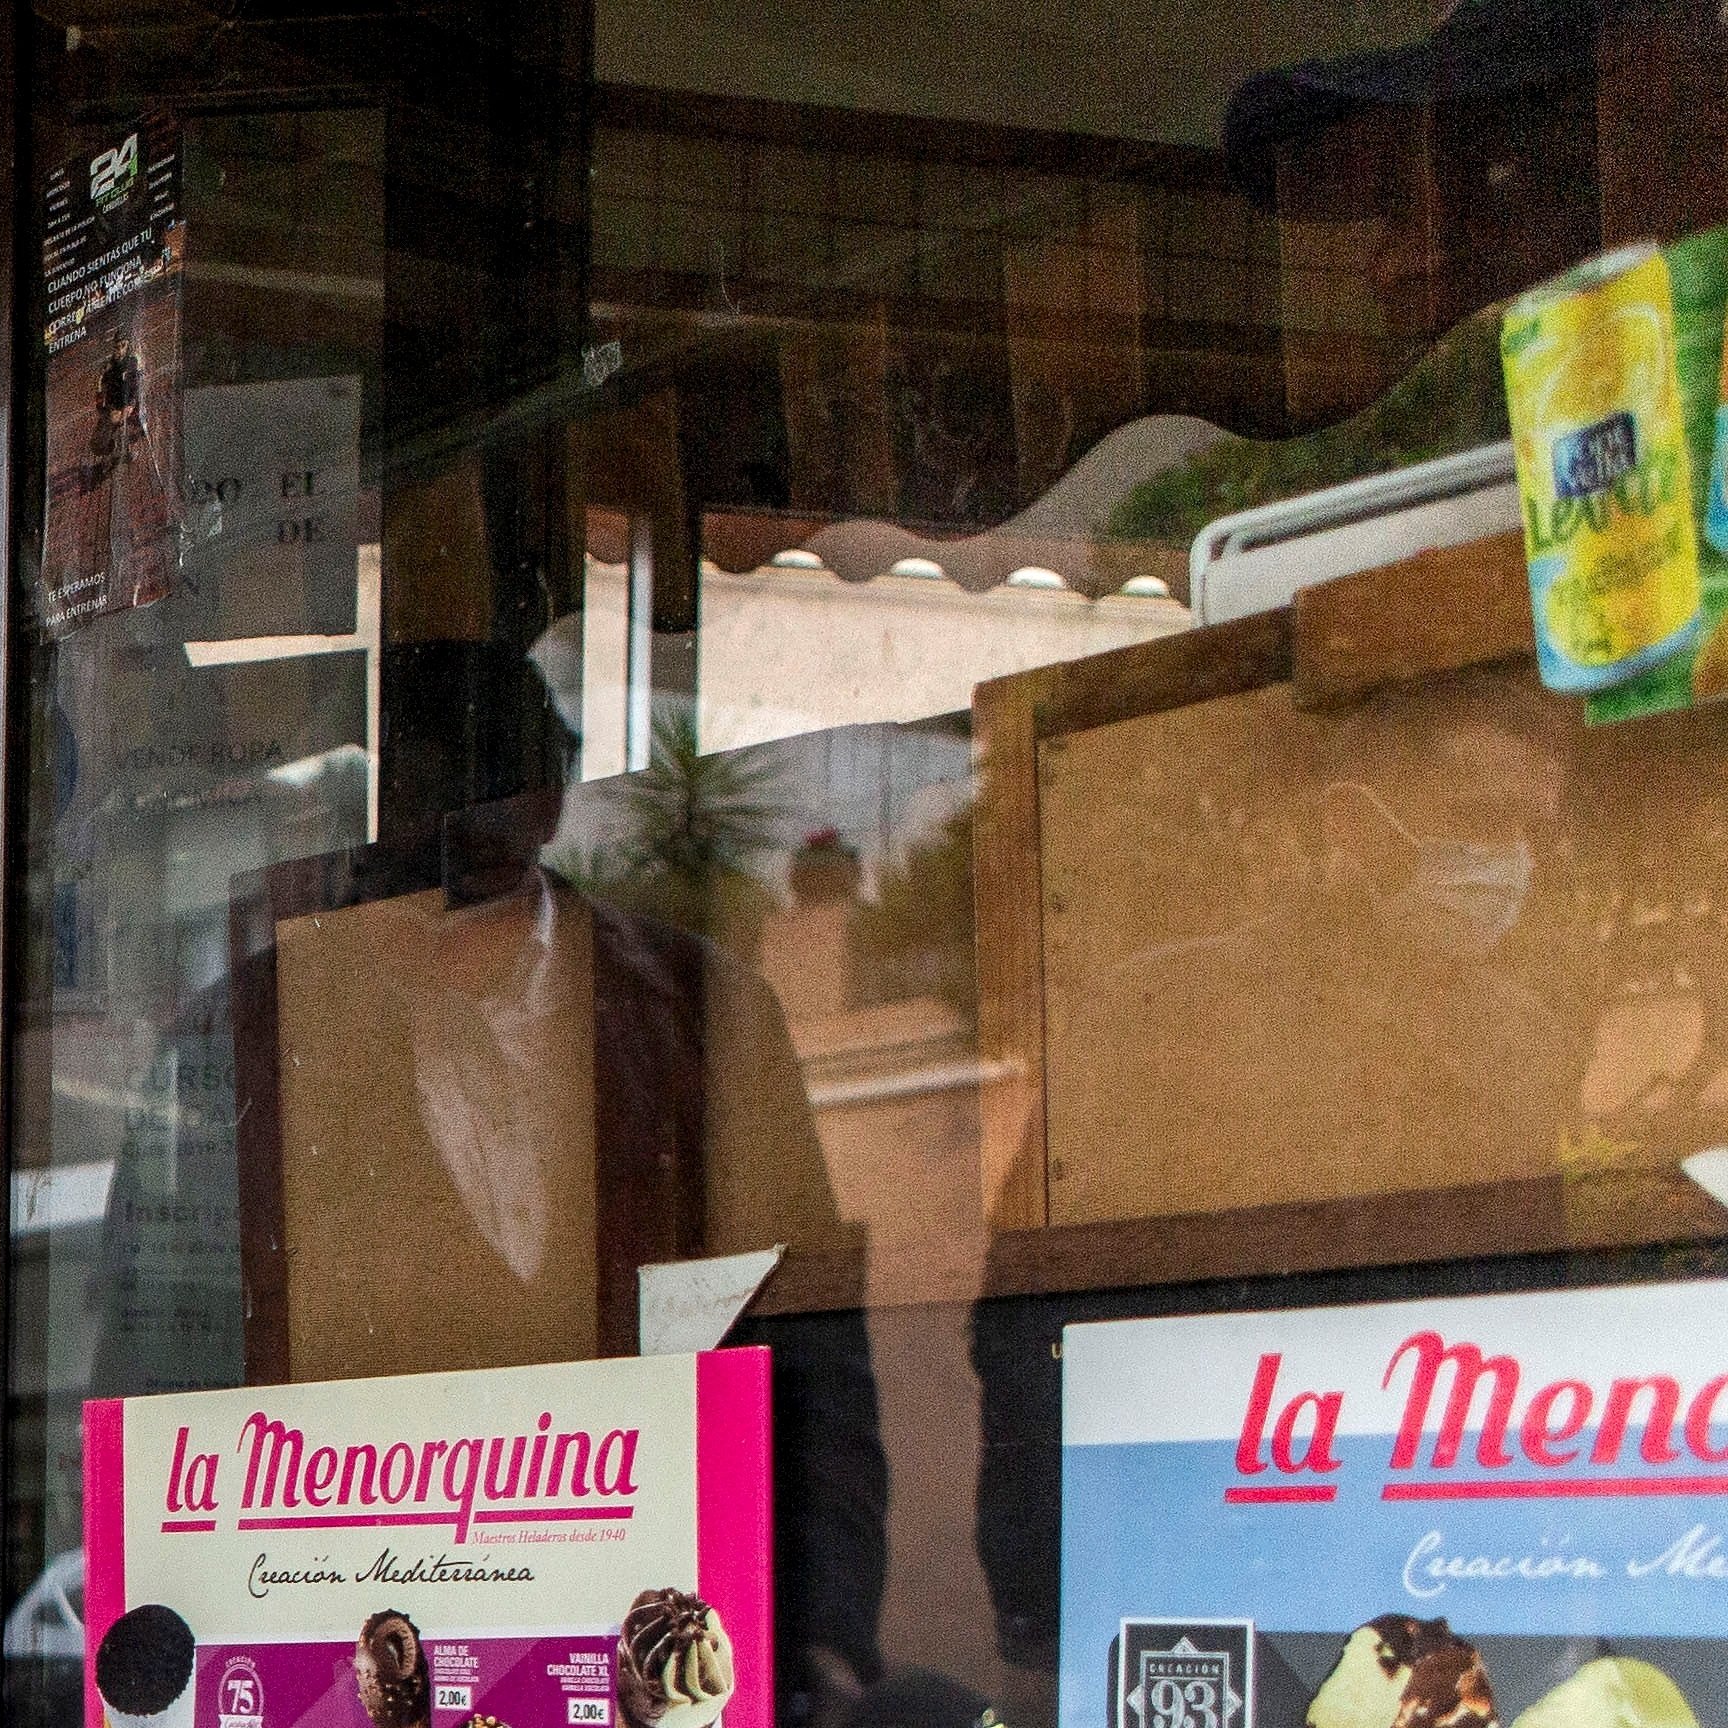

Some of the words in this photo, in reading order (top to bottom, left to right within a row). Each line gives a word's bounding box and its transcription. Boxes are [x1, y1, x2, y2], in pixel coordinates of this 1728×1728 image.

[90, 133, 138, 199] 24
[48, 267, 85, 294] CUANDO
[87, 247, 121, 274] SIENTAS
[122, 236, 140, 254] QUE
[48, 290, 83, 314] CUERPO
[48, 326, 87, 354] ENTRENA
[1235, 1353, 1344, 1476] la
[166, 1426, 218, 1513] la
[238, 1411, 640, 1544] Menorquina
[472, 1529, 517, 1546] Maestros
[518, 1528, 567, 1544] Heladeros
[569, 1528, 598, 1543] desde
[600, 1527, 626, 1542] 1940
[248, 1552, 346, 1598] Creación
[355, 1549, 536, 1584] Mediterránea
[1402, 1530, 1609, 1600] Creación
[433, 1656, 479, 1669] CHOCOLATE
[547, 1664, 594, 1677] CHOCOLATE
[569, 1653, 609, 1665] VAINILLA
[227, 1679, 255, 1715] 75
[439, 1689, 467, 1707] 2,00€
[573, 1702, 605, 1721] 2,00€
